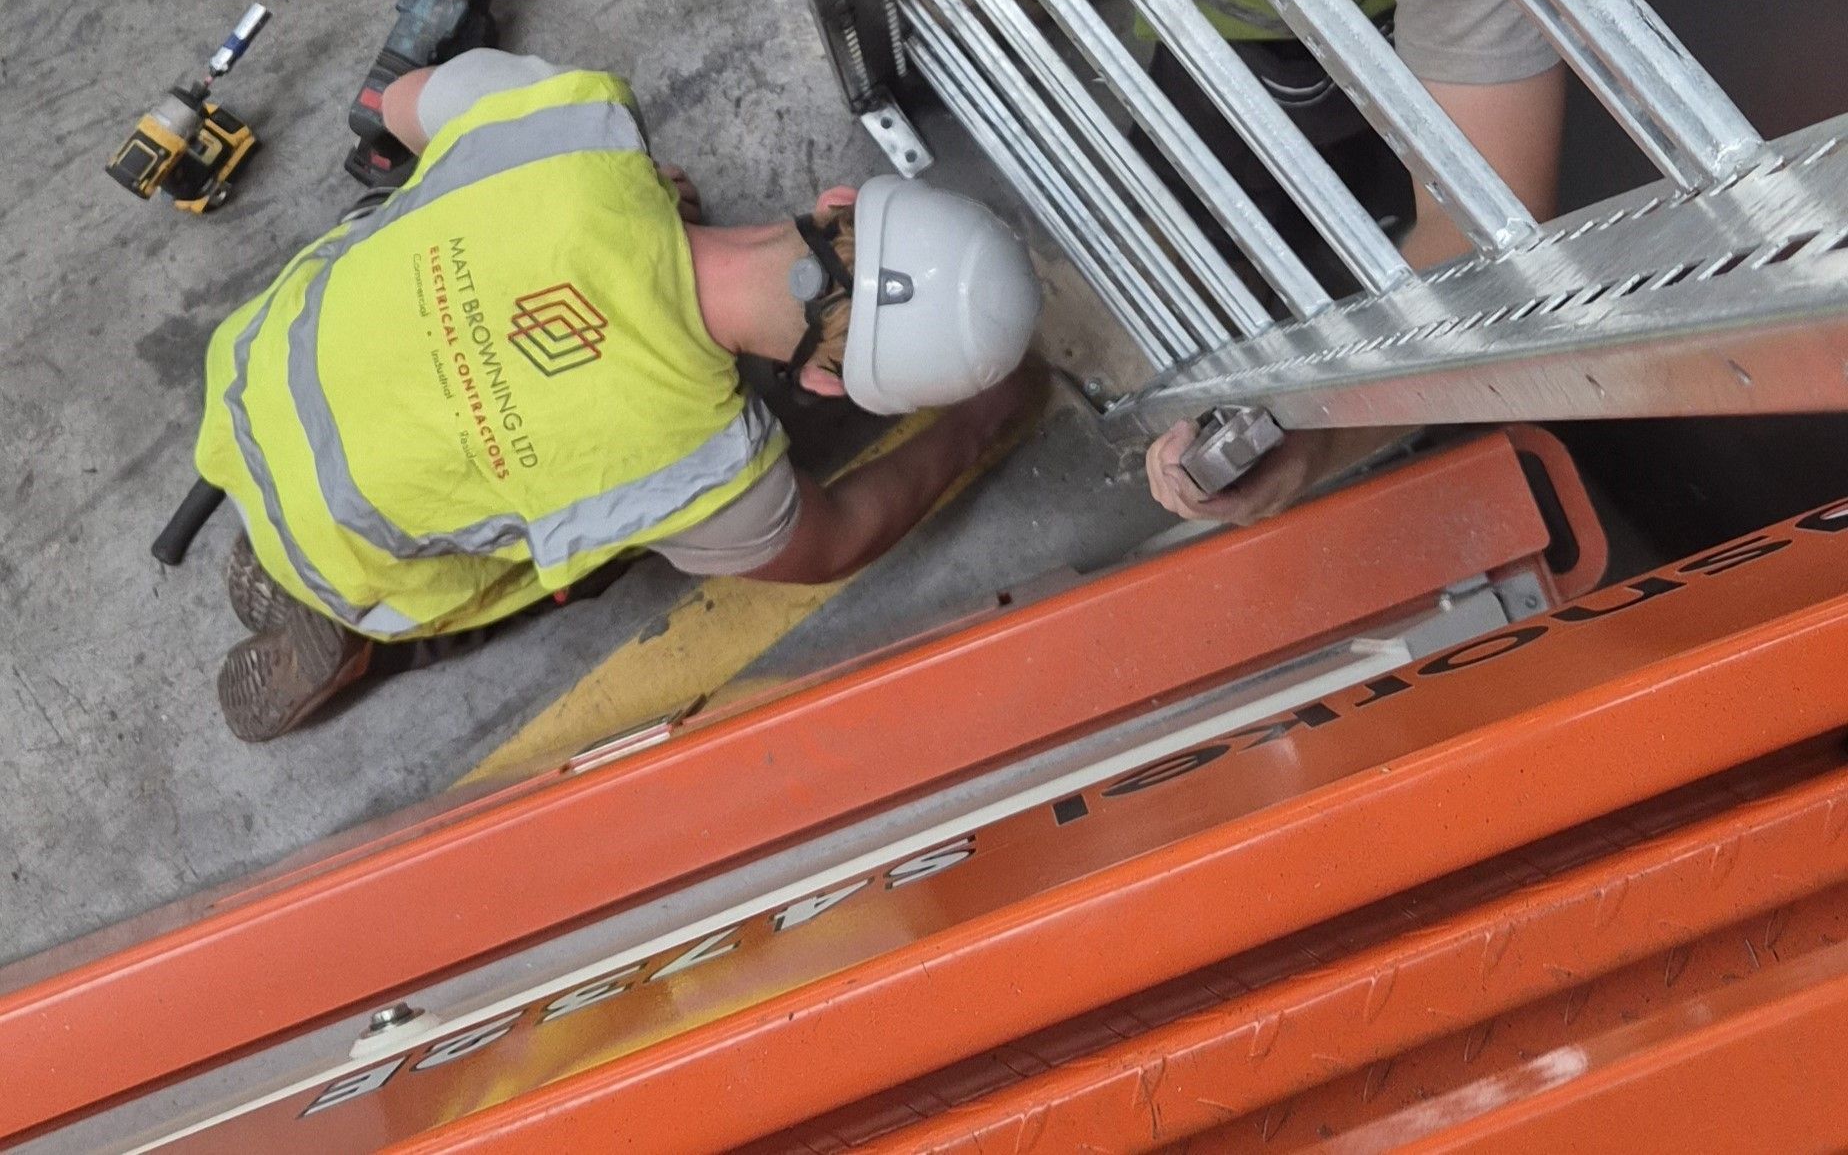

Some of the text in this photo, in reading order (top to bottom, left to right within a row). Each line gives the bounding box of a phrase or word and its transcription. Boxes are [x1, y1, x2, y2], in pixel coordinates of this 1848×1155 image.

[430, 245, 509, 480] ELECTRICAL CONTRACTORS
[449, 237, 538, 469] MATT BROWNING LTD
[297, 535, 1793, 1119] snorkel S4732E
